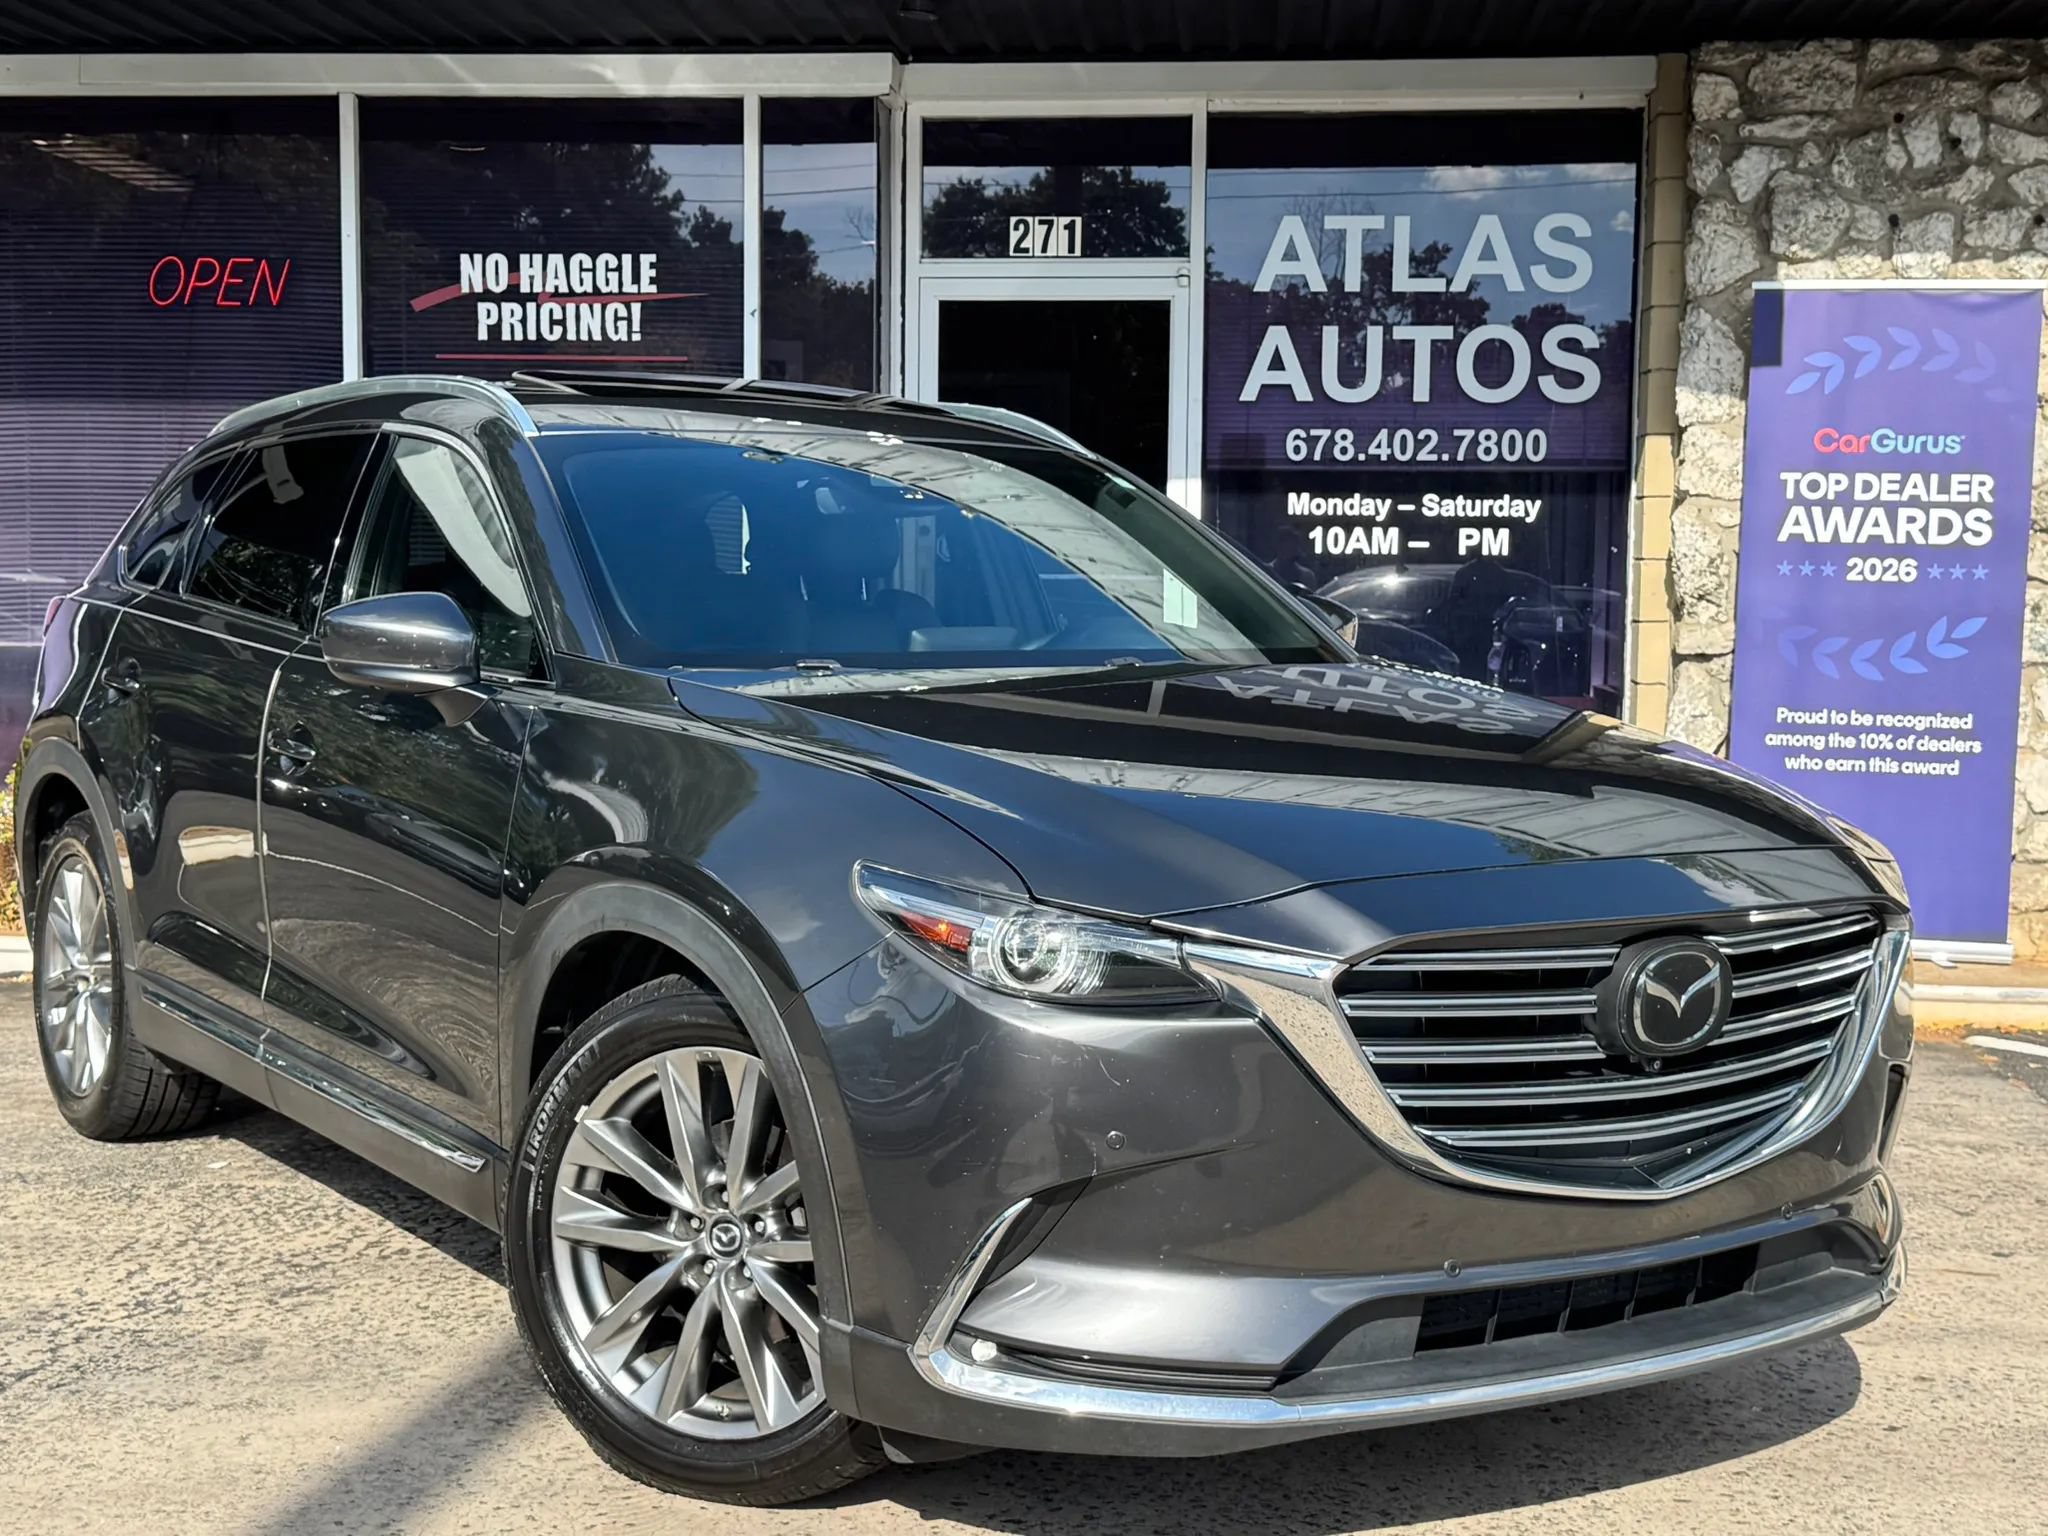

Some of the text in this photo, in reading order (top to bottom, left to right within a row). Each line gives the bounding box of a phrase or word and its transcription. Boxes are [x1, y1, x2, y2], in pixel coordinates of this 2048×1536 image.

[1012, 218, 1079, 255] 271
[1253, 212, 1593, 293] ATLAS
[149, 255, 290, 307] OPEN
[460, 252, 658, 295] NO HAGGLE
[476, 301, 642, 342] PRICING!
[1239, 323, 1601, 404] AUTOS
[1285, 428, 1548, 462] 678.402.7800
[1813, 428, 1965, 454] CarGurus
[1779, 472, 1995, 503] TOP DEALER
[1287, 492, 1392, 521] Monday
[1421, 494, 1542, 522] Saturday
[1308, 526, 1400, 555] 10AM
[1458, 528, 1510, 556] PM
[1776, 505, 1994, 546] AWARDS
[1846, 557, 1918, 582] 2026
[1776, 707, 1974, 731] Proud to be recognized
[1765, 732, 1983, 754] among the 10% of dealers
[1785, 755, 1960, 776] who earn this award
[526, 1048, 596, 1159] IRONMAN
